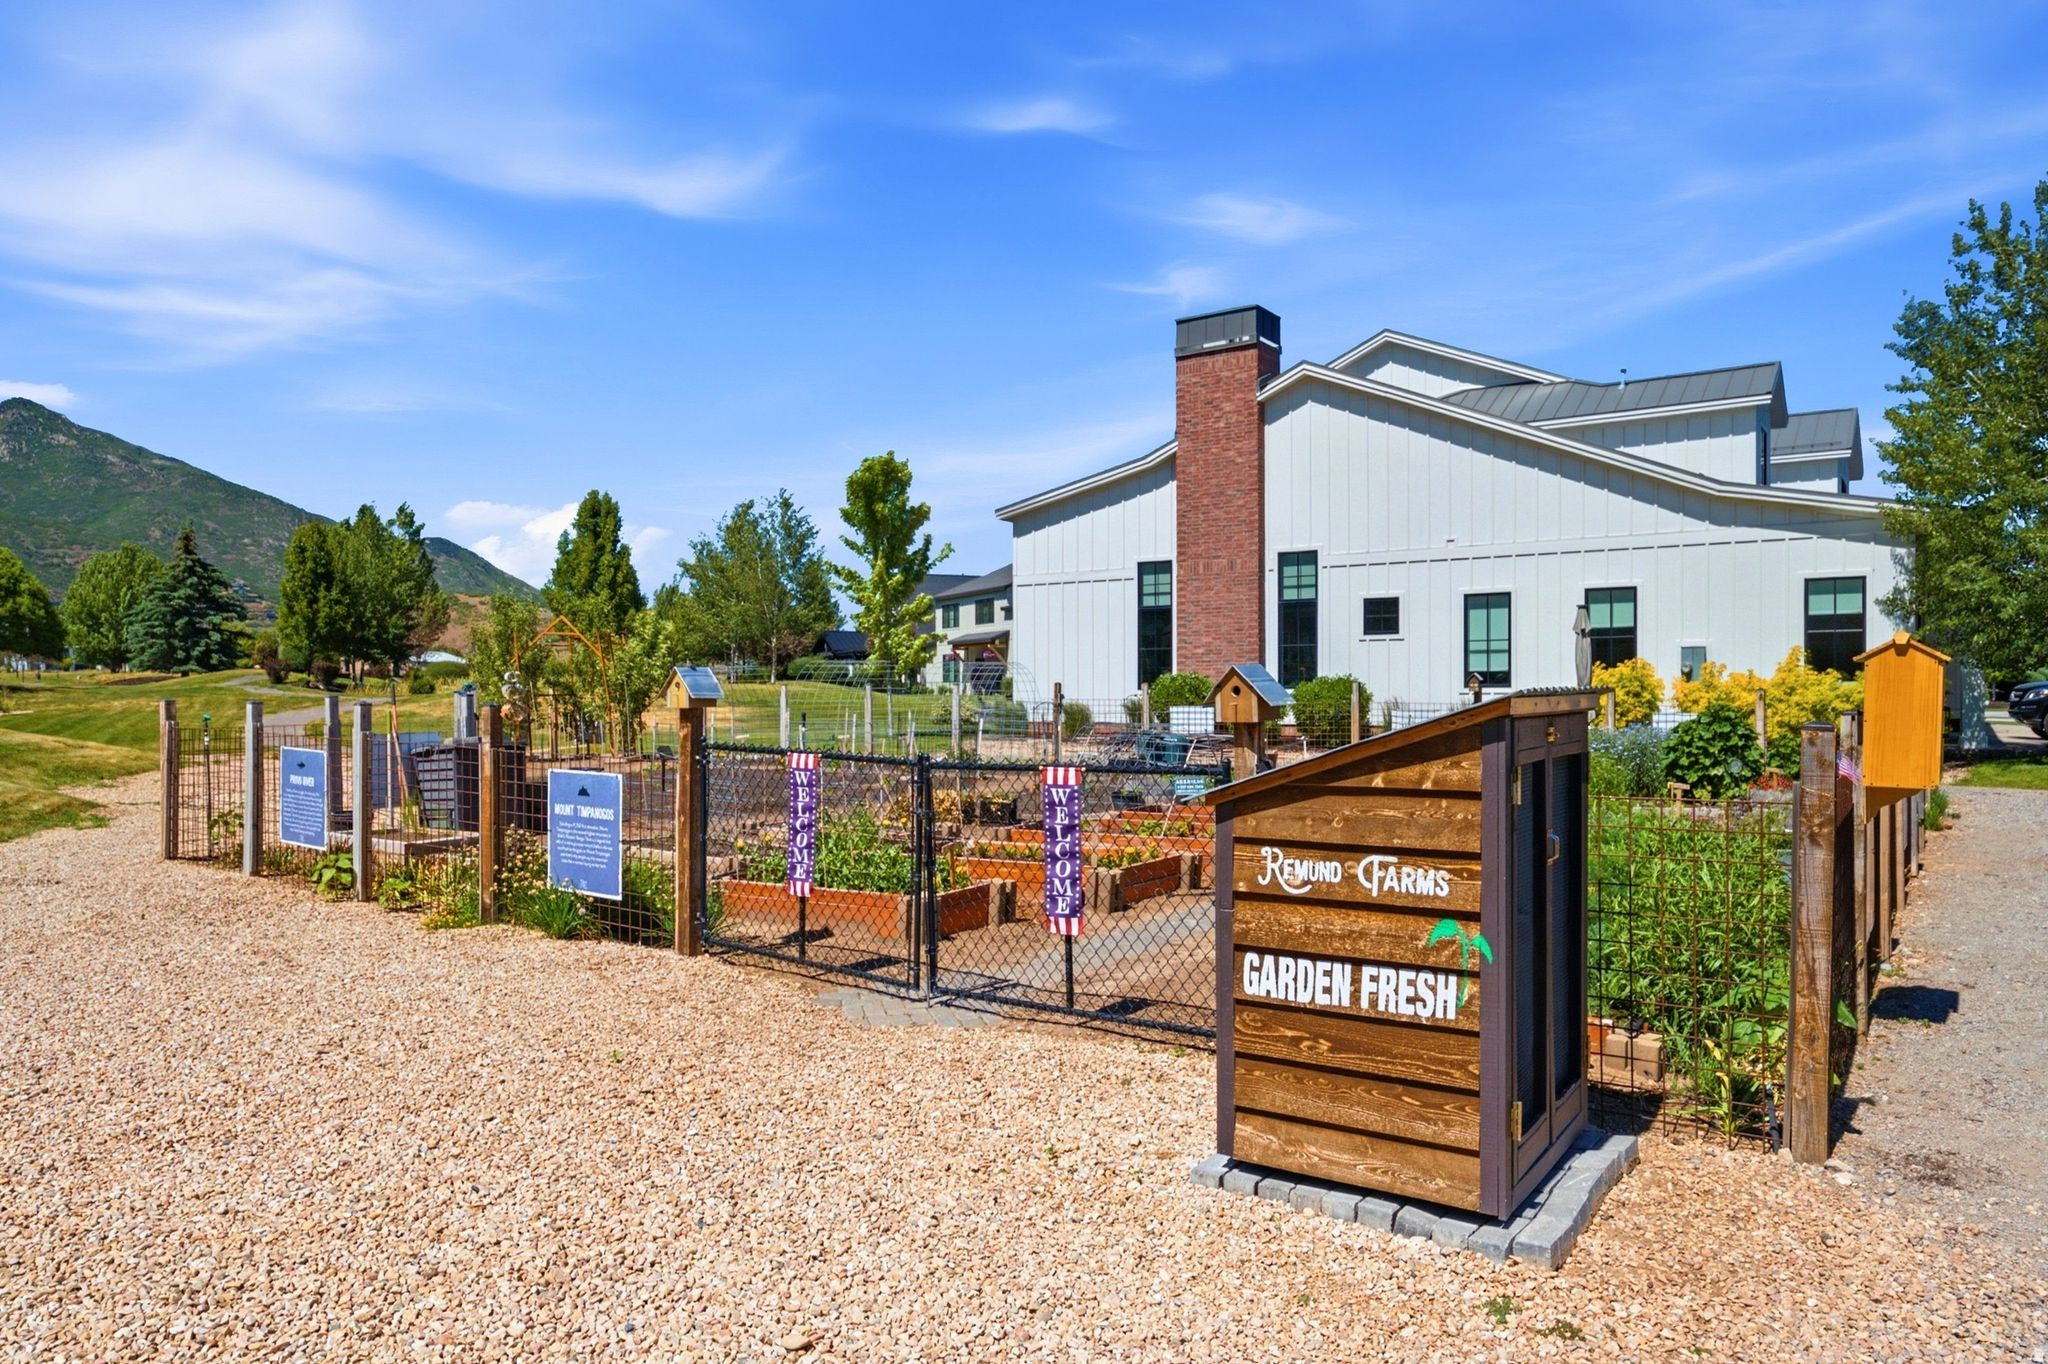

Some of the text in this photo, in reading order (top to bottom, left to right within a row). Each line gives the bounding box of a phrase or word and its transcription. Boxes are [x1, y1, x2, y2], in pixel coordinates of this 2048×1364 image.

[554, 803, 614, 821] MOUNT TIMPANOGOS
[792, 770, 811, 879] WELCOME
[1050, 787, 1073, 914] WELCOME
[1243, 952, 1458, 1020] GARDEN FRESH
